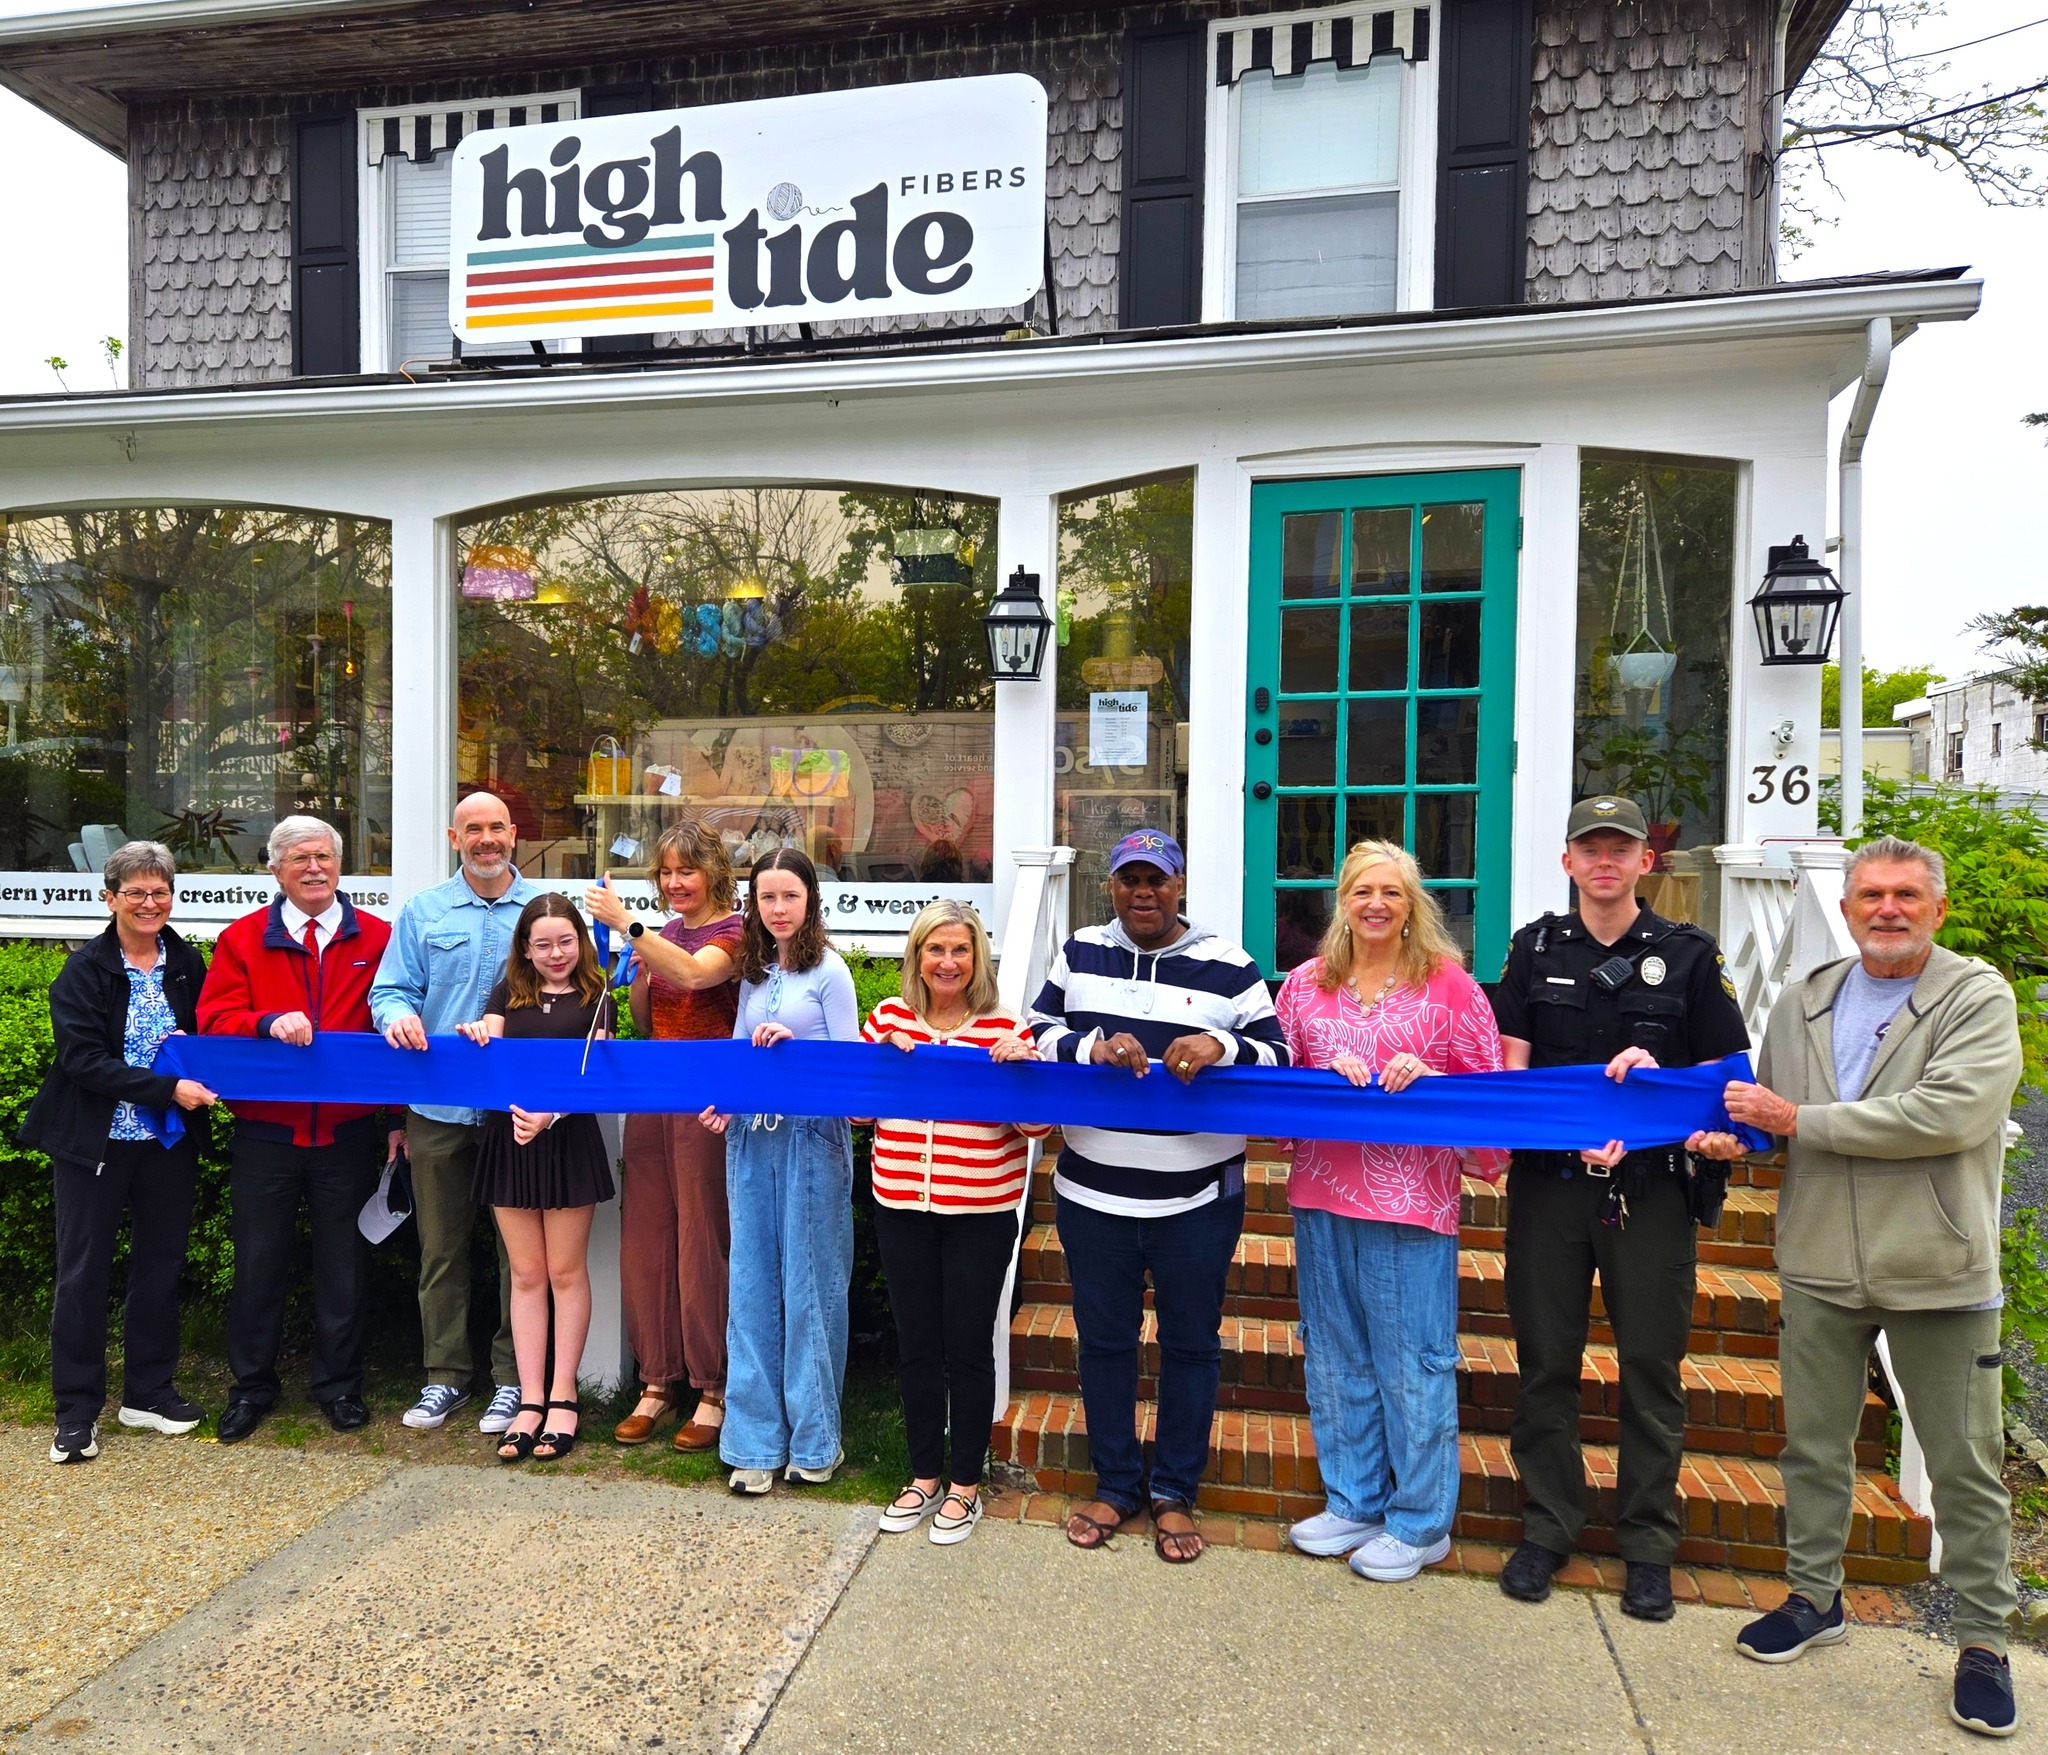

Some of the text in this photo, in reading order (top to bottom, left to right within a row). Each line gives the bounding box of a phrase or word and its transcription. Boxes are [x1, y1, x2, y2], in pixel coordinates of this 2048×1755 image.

[477, 125, 727, 248] high
[901, 166, 1027, 196] FIBERS
[722, 182, 974, 309] tide
[1098, 698, 1119, 708] high
[1118, 703, 1138, 713] tide
[1747, 765, 1810, 805] 36
[0, 887, 37, 901] ern
[42, 887, 92, 905] yarn
[179, 886, 268, 904] creative
[836, 893, 859, 914] &
